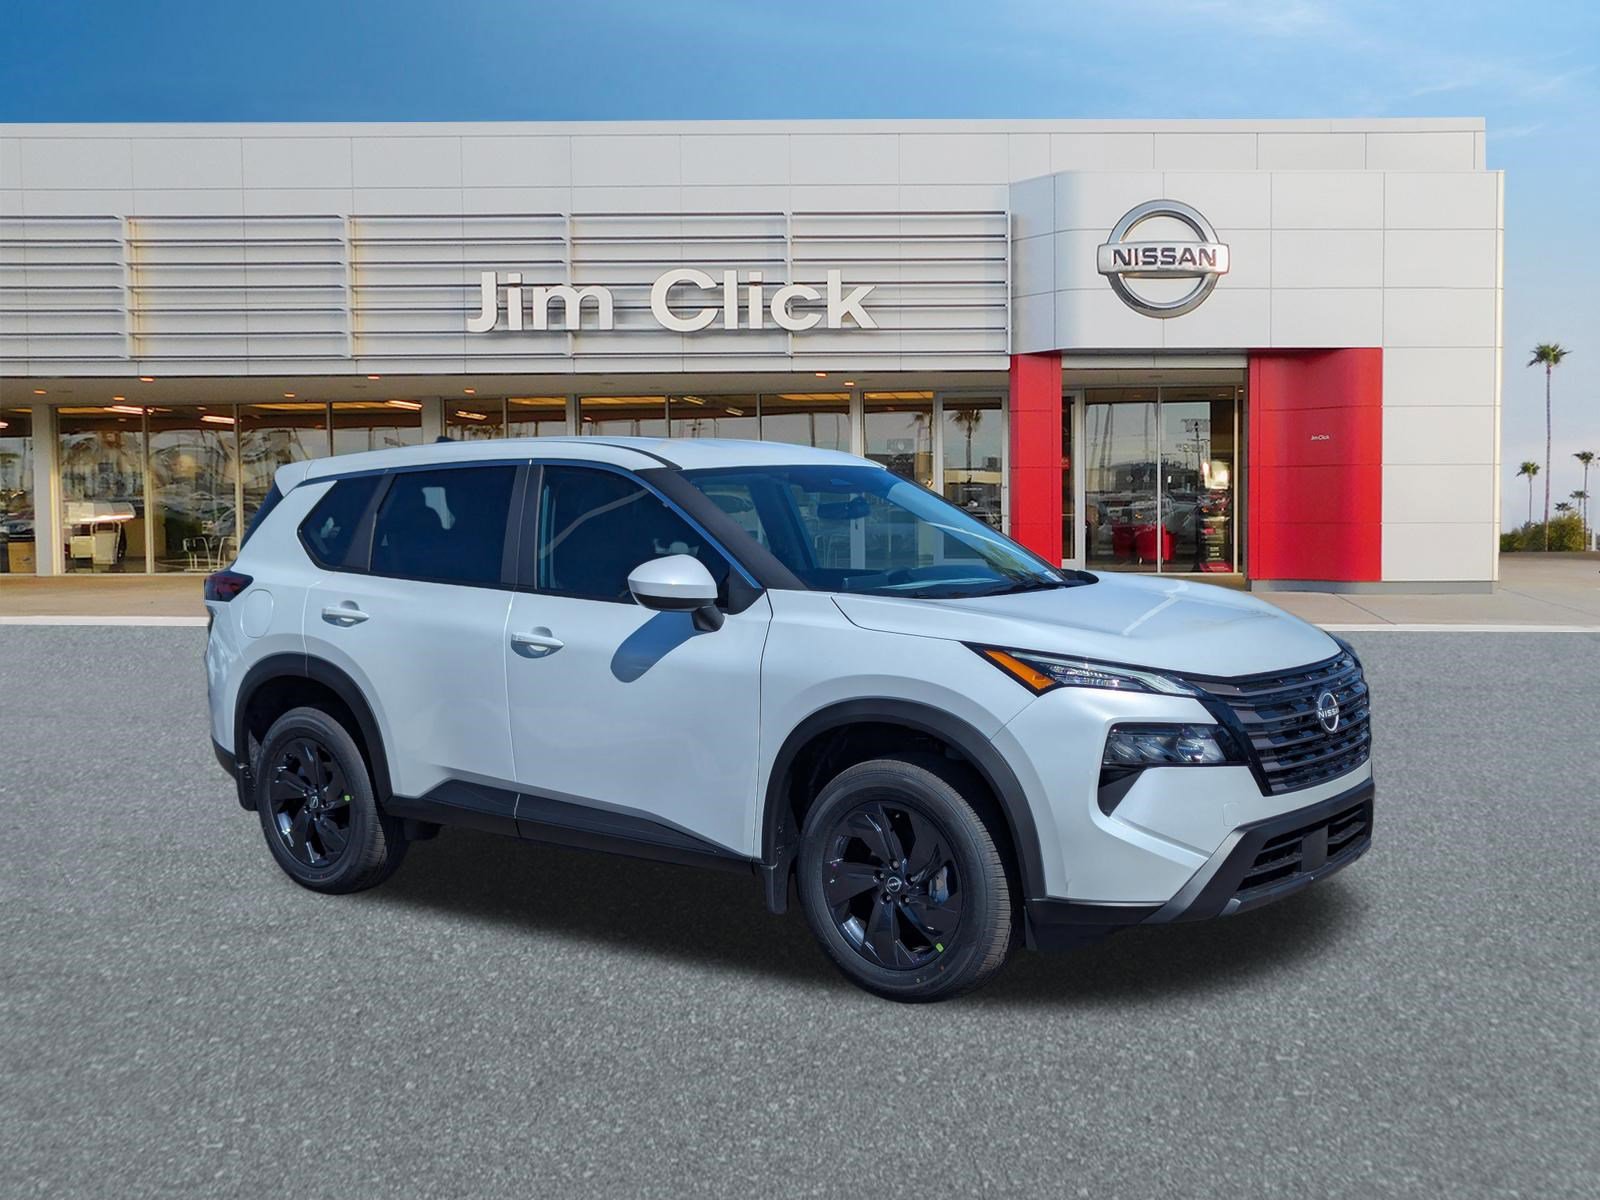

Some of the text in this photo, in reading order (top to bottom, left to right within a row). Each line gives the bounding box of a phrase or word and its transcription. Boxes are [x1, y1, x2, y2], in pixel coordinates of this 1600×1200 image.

[1112, 247, 1217, 267] NISSAN
[467, 268, 879, 333] Jim Click
